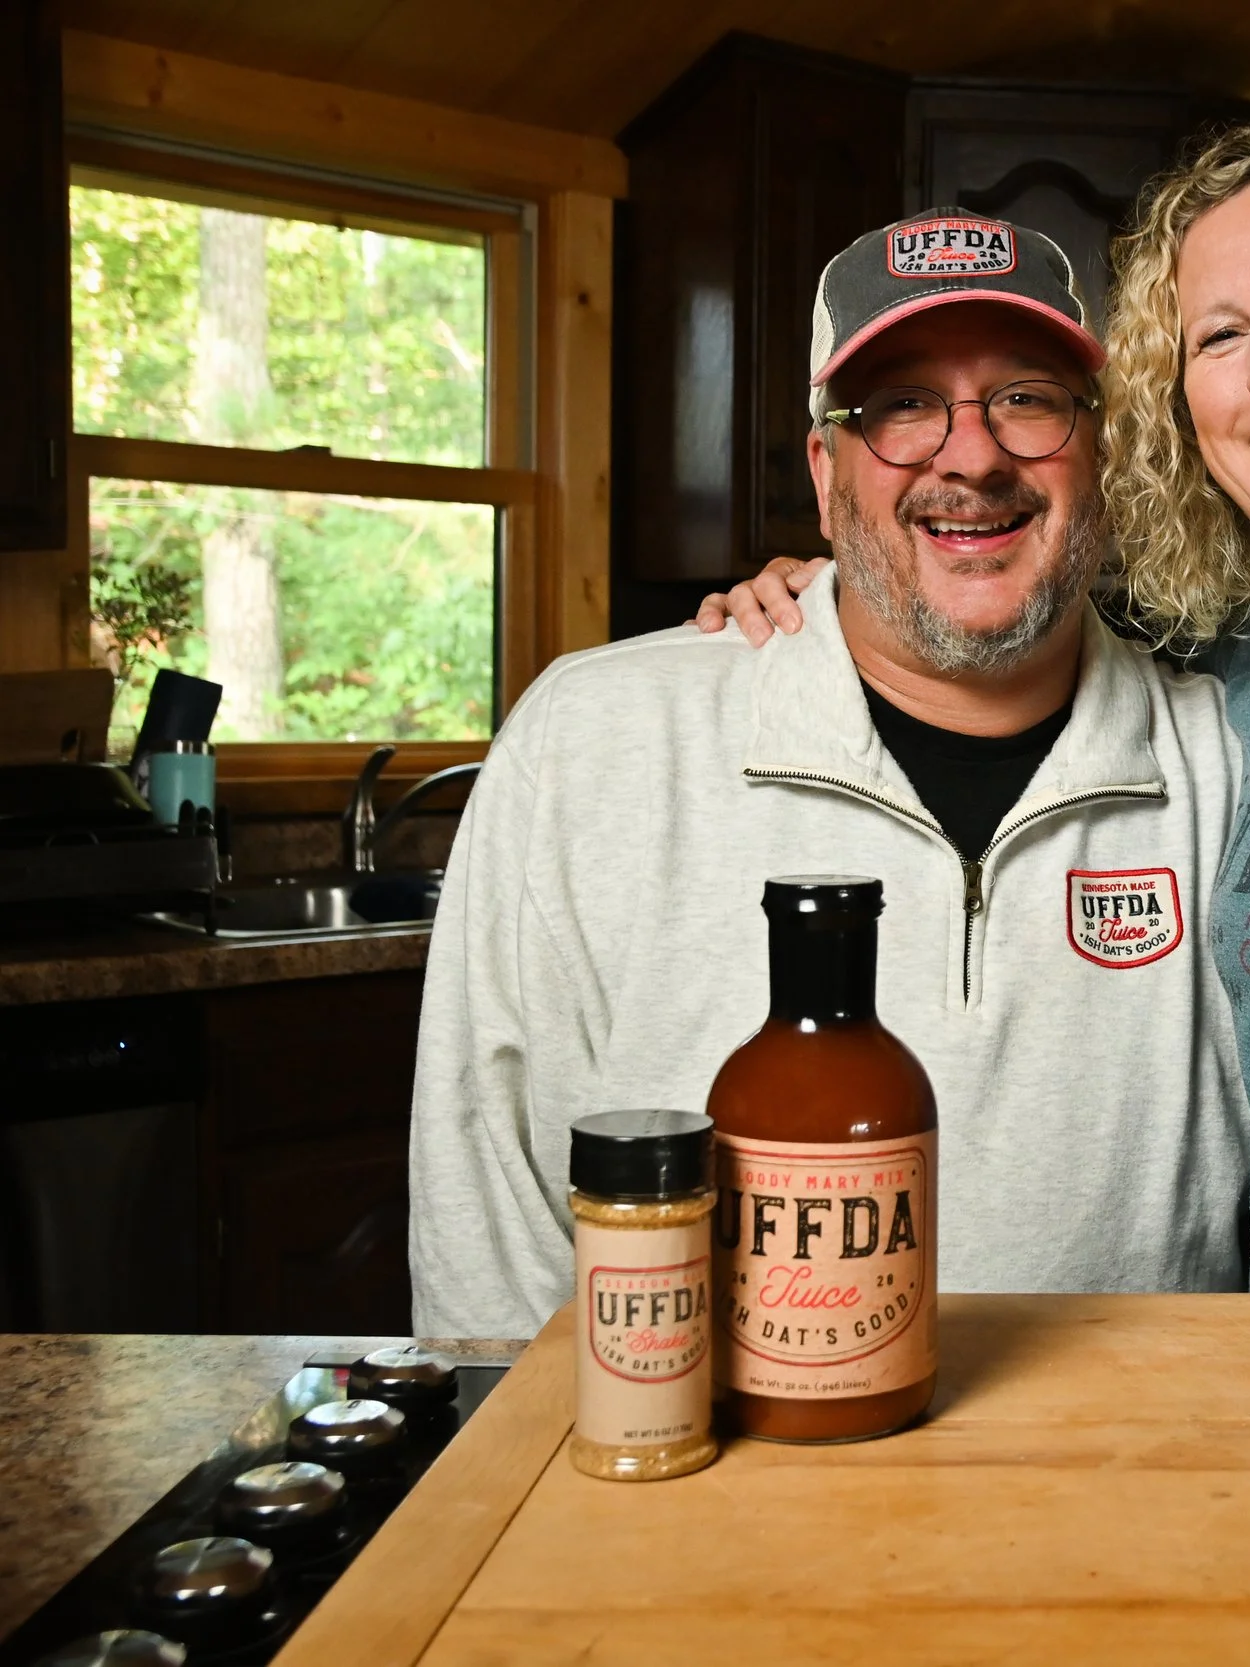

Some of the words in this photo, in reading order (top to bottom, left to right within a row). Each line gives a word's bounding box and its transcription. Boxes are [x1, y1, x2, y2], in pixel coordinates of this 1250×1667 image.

[901, 222, 941, 236] BLOODY
[946, 221, 976, 229] MARY
[980, 224, 1001, 234] MIX
[896, 229, 1008, 254] UFFDA
[908, 252, 925, 262] 20
[927, 247, 977, 262] Juice
[928, 263, 967, 271] DAT'S
[973, 259, 1003, 270] GOOD
[1082, 883, 1128, 893] MINNESOTA
[1130, 881, 1156, 890] MADE
[1080, 892, 1163, 918] UFFDA
[1085, 921, 1095, 930] 20
[1099, 918, 1148, 942] Juice
[1149, 918, 1160, 927] 20
[1084, 934, 1101, 951] ISH
[1103, 944, 1133, 956] DAT'S
[1136, 932, 1167, 953] GOOD
[738, 1170, 791, 1189] OODY
[806, 1174, 862, 1190] MARY
[873, 1168, 904, 1187] MIX
[715, 1186, 917, 1260] UFFDA
[605, 1277, 670, 1291] SEASON
[759, 1265, 862, 1309] Juice
[597, 1282, 708, 1327] UFFDA
[762, 1321, 838, 1346] DAT'S
[853, 1292, 910, 1338] GOOD
[626, 1328, 690, 1354] Shake
[633, 1358, 675, 1372] DAT'S
